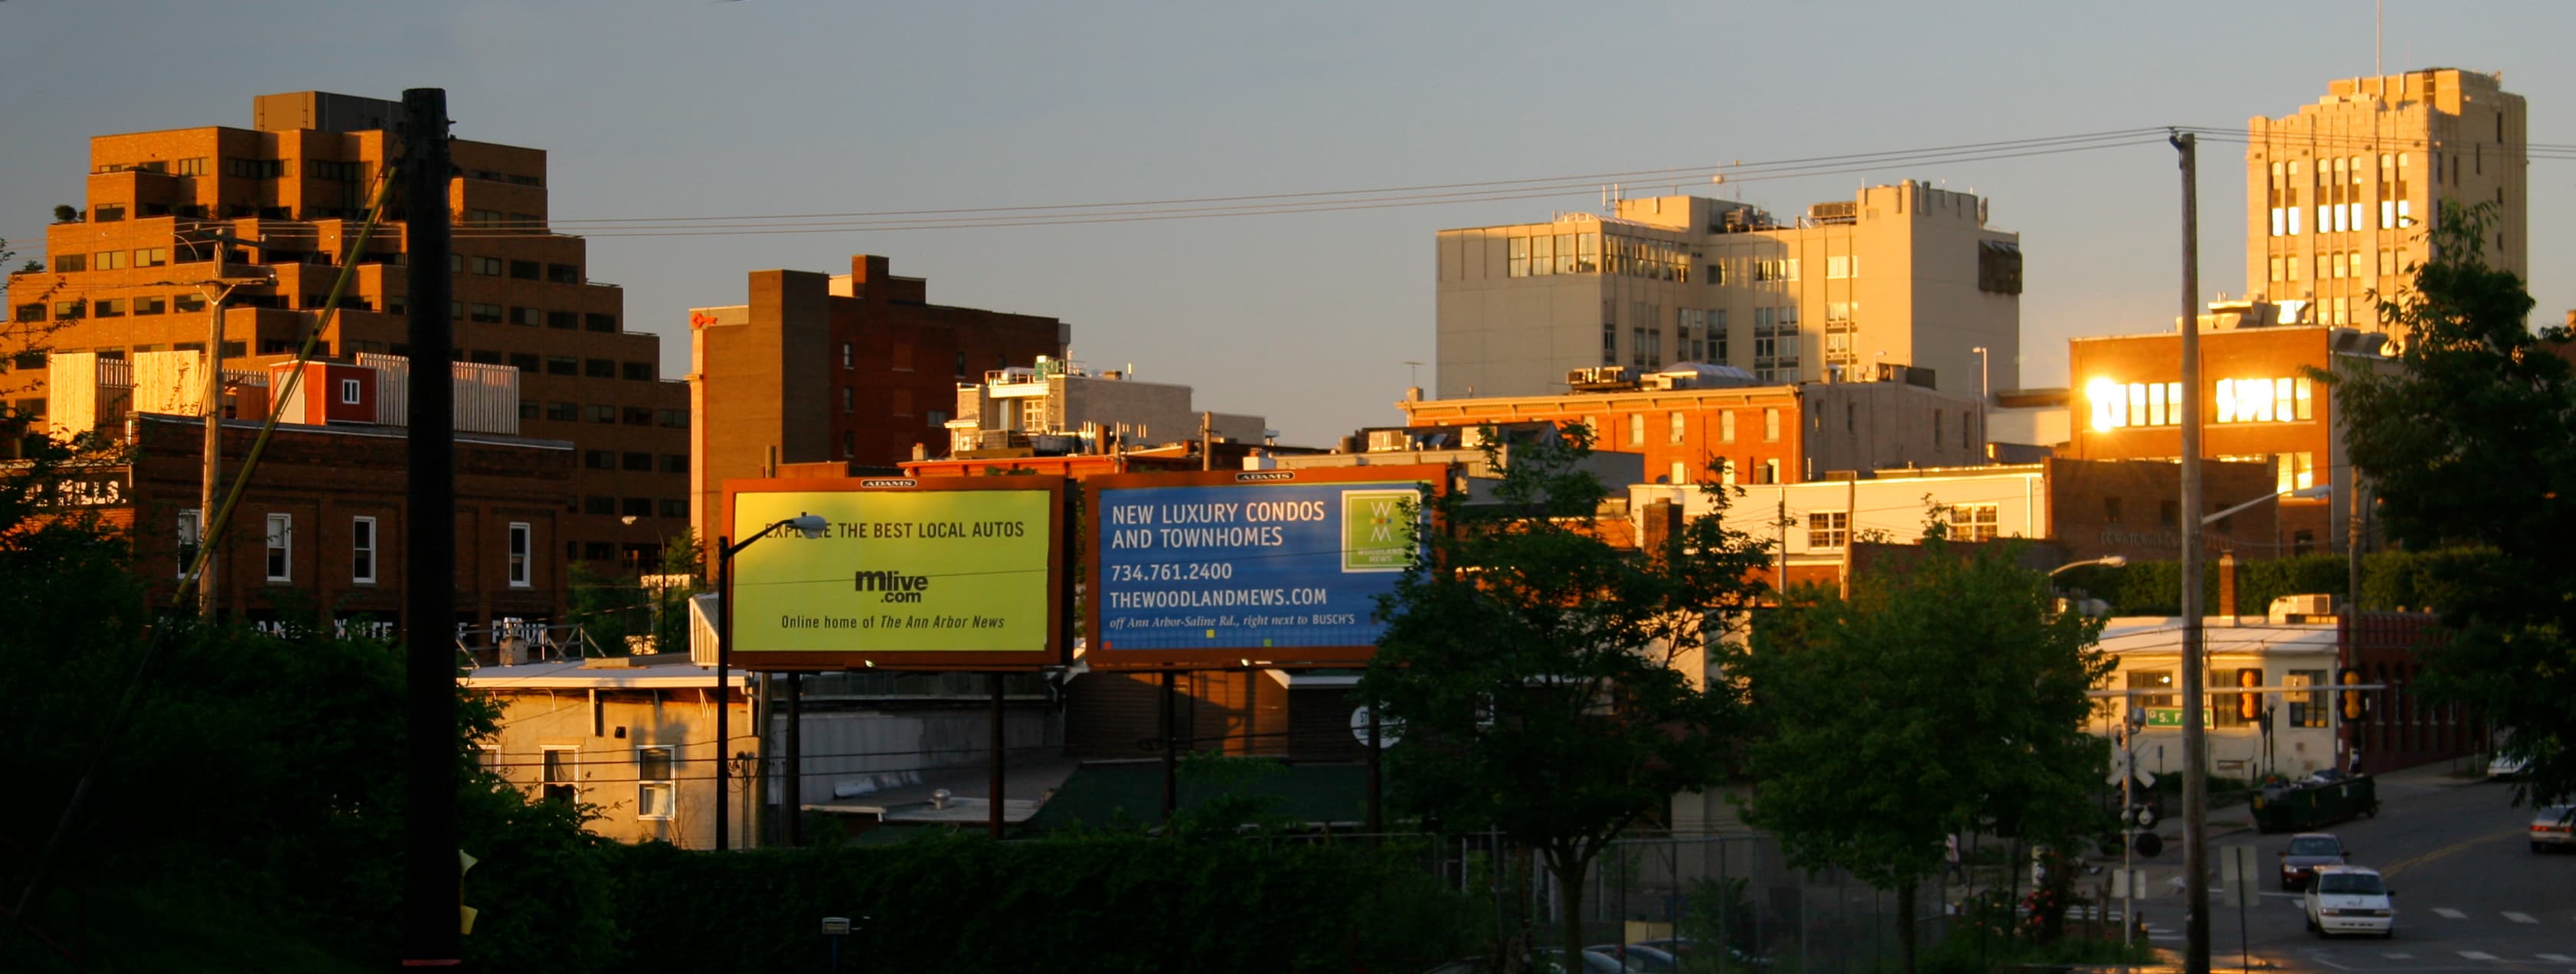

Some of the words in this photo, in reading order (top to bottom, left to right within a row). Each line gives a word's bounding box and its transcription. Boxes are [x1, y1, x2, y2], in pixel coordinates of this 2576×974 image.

[1113, 505, 1154, 525] NEW
[1162, 503, 1238, 524] LUXURY
[1246, 501, 1325, 521] CONDOS
[1371, 502, 1393, 517] W
[765, 522, 832, 538] EXPLE
[839, 523, 868, 538] THE
[874, 522, 914, 538] BEST
[920, 522, 966, 538] LOCAL
[972, 521, 1025, 538] AUTOS
[1112, 529, 1152, 549] AND
[1159, 526, 1283, 547] TOWNHOMES
[1371, 525, 1391, 542] M
[855, 570, 929, 591] mlive
[1111, 563, 1232, 581] 734.761.2400
[881, 591, 922, 603] .com
[1110, 588, 1327, 608] THEWOODLANDMEWS.COM
[781, 616, 819, 629] Online
[825, 616, 857, 629] home
[863, 616, 876, 629] of
[881, 615, 902, 629] The
[905, 616, 929, 629] Ann
[932, 616, 968, 629] Arbor
[972, 616, 1005, 629] News
[1110, 616, 1126, 629] off
[1126, 616, 1149, 628] Ann
[1152, 616, 1216, 627] Arbor-Saline
[1219, 616, 1240, 628] Rd.,
[1243, 615, 1268, 629] right
[1272, 616, 1295, 625] next
[1297, 615, 1308, 625] to
[1312, 614, 1355, 625] BUSCH'S
[2159, 712, 2169, 724] S.
